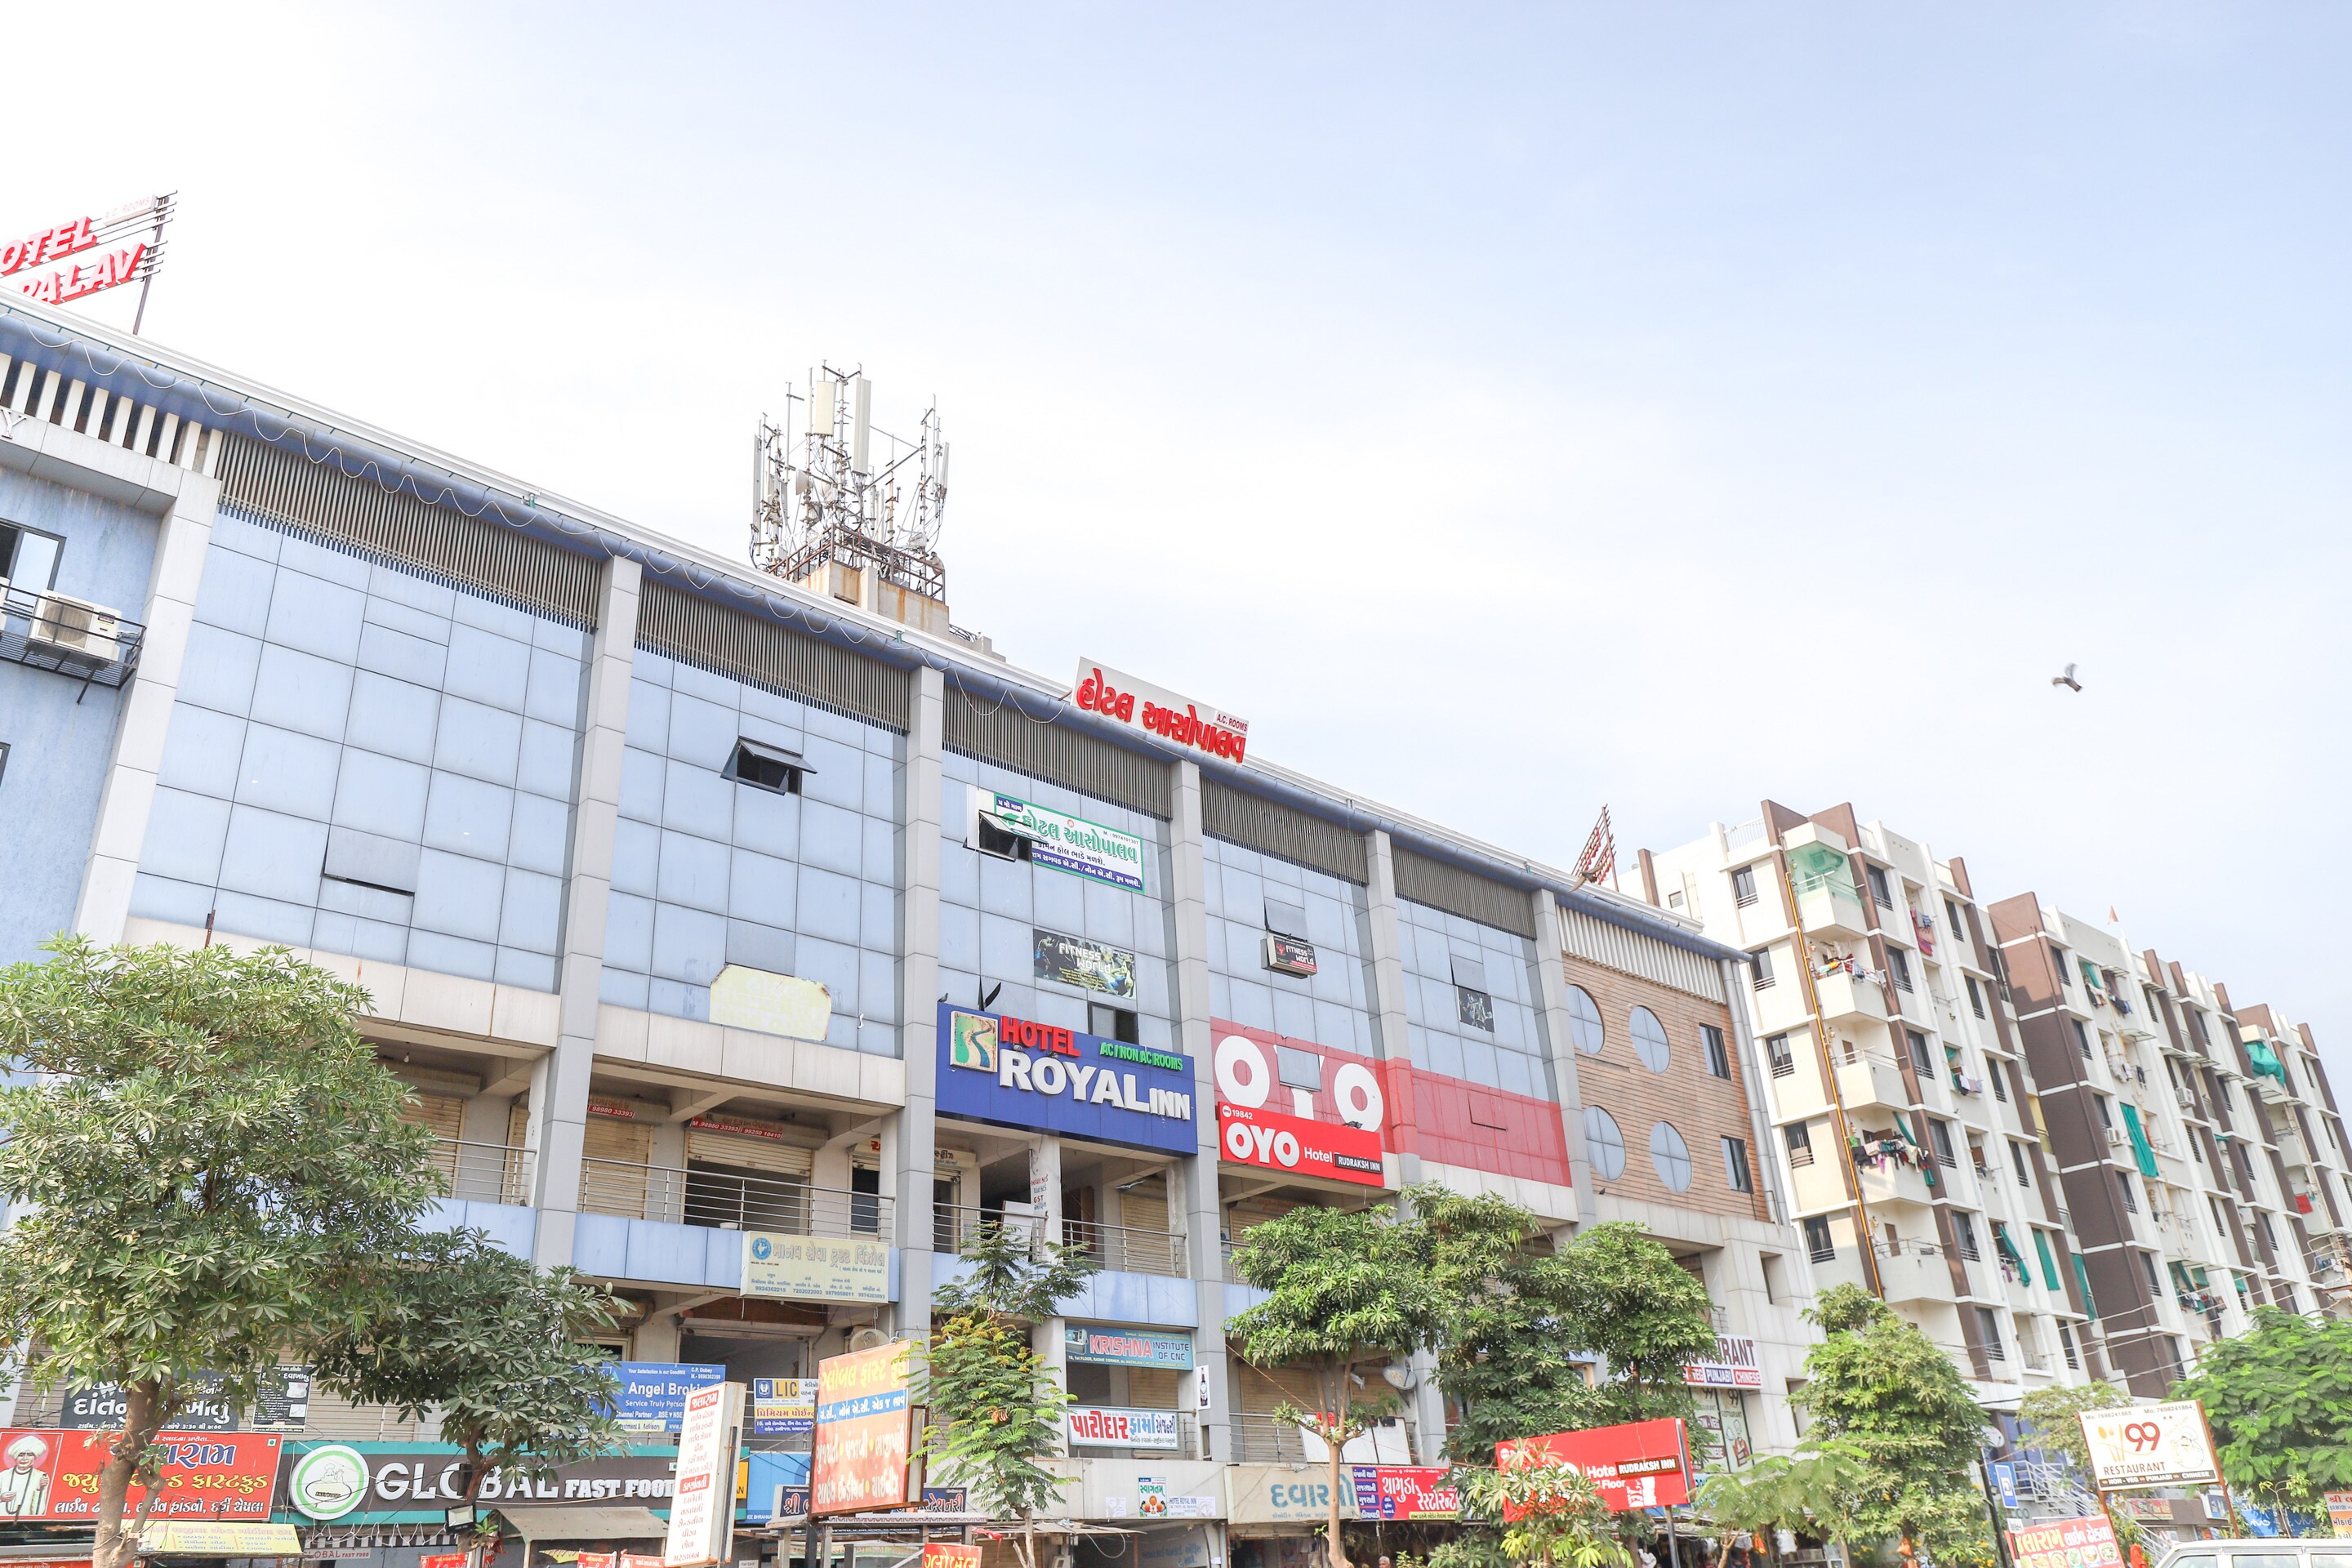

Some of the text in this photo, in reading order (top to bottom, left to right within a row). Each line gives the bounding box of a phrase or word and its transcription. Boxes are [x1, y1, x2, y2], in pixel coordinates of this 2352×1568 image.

[122, 196, 150, 212] ROOMS
[0, 216, 97, 276] OTEL
[1076, 667, 1135, 724] હોટલ
[1216, 713, 1248, 733] A.C. ROOMS
[1071, 850, 1085, 860] ભાડે
[1058, 942, 1101, 961] FITNESS
[1285, 945, 1307, 956] FITNESS
[1000, 1015, 1080, 1057] HOTEL
[1153, 1053, 1183, 1071] ROOMS
[999, 1049, 1191, 1120] ROYAL INN
[592, 1106, 634, 1117] 98980 33393
[1232, 1109, 1253, 1120] 19842
[1226, 1122, 1381, 1171] OYO Hotel RUDRAKSH INN
[1033, 1195, 1044, 1203] GST
[773, 1244, 802, 1260] માનવ
[806, 1241, 826, 1262] સેવા
[1089, 1334, 1190, 1359] KRISHNA INSTITUTE
[1158, 1352, 1186, 1361] OF CNC
[821, 1360, 858, 1392] ગ્લોબલ
[860, 1358, 887, 1388] ફાસ્ટ
[1706, 1368, 1733, 1383] PUNJABI
[1735, 1371, 1762, 1384] CHINESE
[628, 1382, 664, 1398] Angel
[776, 1382, 797, 1397] LIC
[1727, 1388, 1740, 1406] 99
[692, 1392, 718, 1408] જલારામ
[872, 1396, 884, 1410] એક
[757, 1408, 788, 1417] પ્રિમિયમ
[167, 1422, 180, 1430] સાંજે
[1071, 1410, 1129, 1440] પાટીદાર
[1129, 1413, 1156, 1435] ફાર્મા
[2124, 1421, 2161, 1452] 99
[1587, 1459, 1676, 1480] Hote RUDRAKSH INN
[2103, 1461, 2166, 1476] RESTAURANT
[2181, 1471, 2211, 1479] CHINESE
[1601, 1480, 1625, 1490] Floor
[2146, 1474, 2173, 1482] PUNJABI
[564, 1478, 621, 1499] FAST
[1140, 1485, 1165, 1497] સ્વાગતમ્
[55, 1496, 87, 1514] લાઈવ
[234, 1497, 264, 1512] થેપલા
[684, 1493, 702, 1503] દાબેલી
[783, 1493, 800, 1514] શ્રી
[2329, 1494, 2342, 1503] શ્રી
